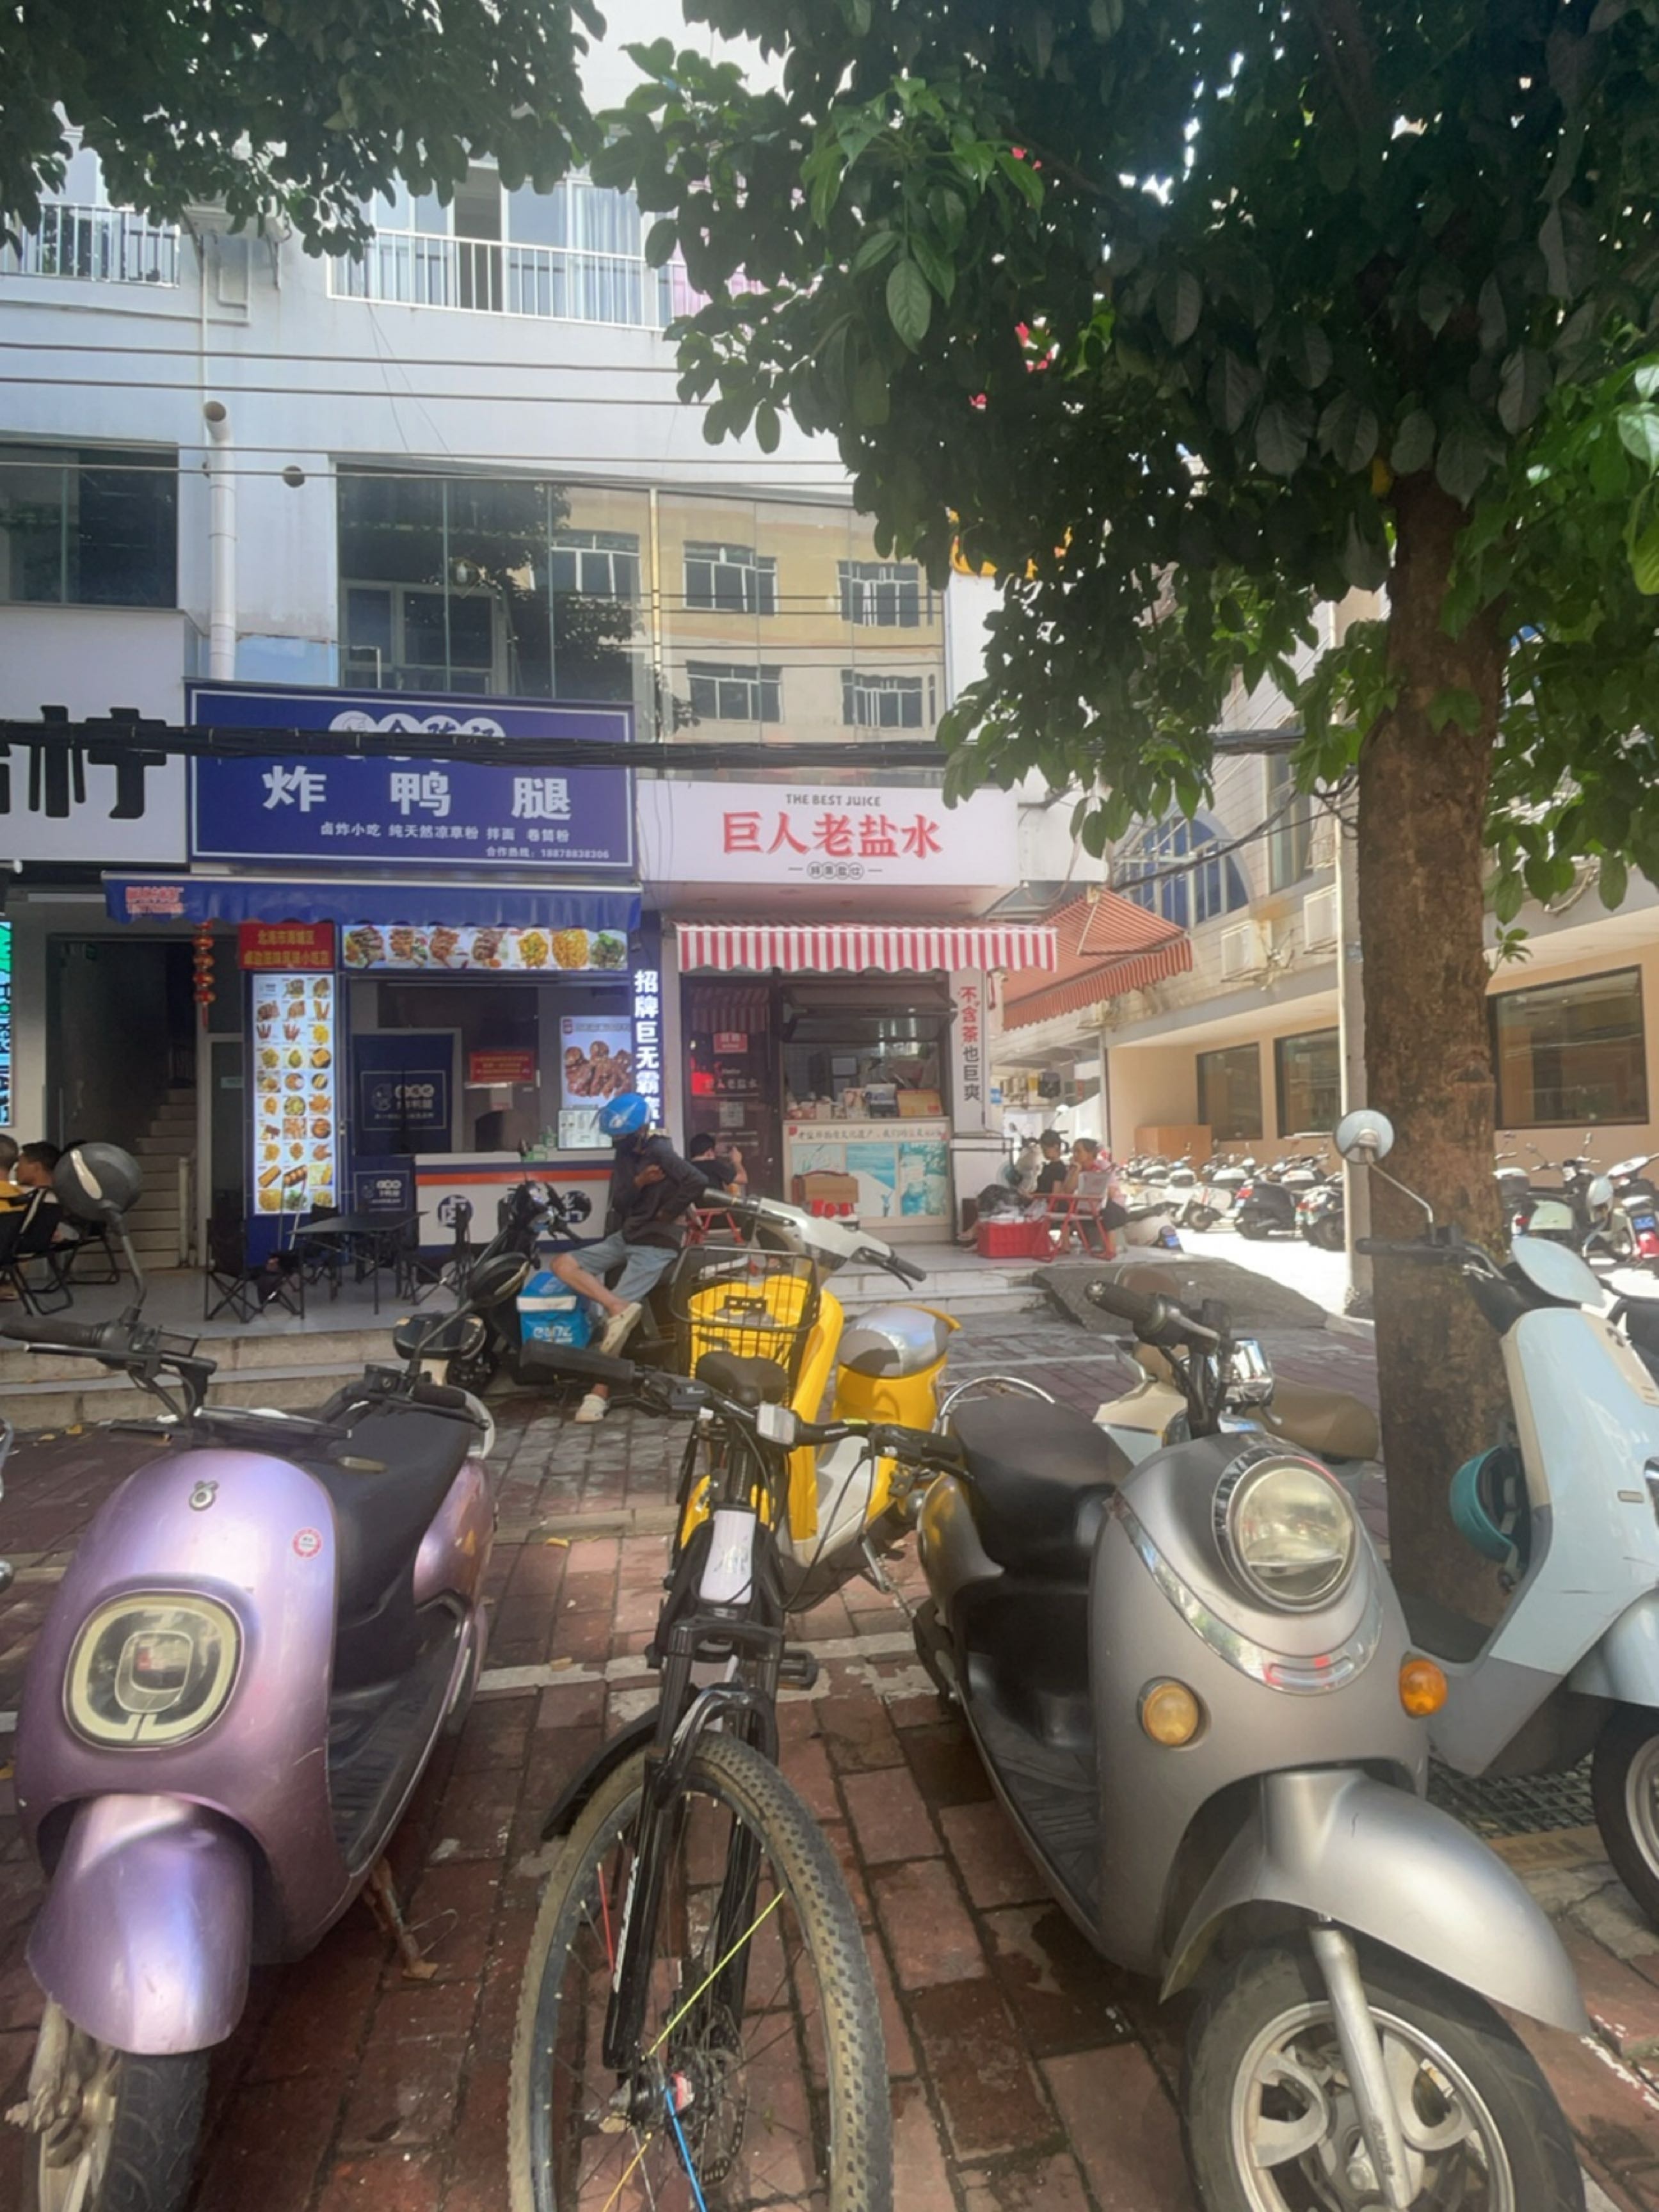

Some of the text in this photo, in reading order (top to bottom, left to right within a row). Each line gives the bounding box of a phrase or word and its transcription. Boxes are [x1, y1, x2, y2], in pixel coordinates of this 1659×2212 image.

[262, 765, 572, 820] 炸鸭腿
[787, 793, 881, 806] THE BEST JUICE
[321, 821, 381, 837] 卤炸小吃
[722, 811, 943, 859] 巨人老盐水
